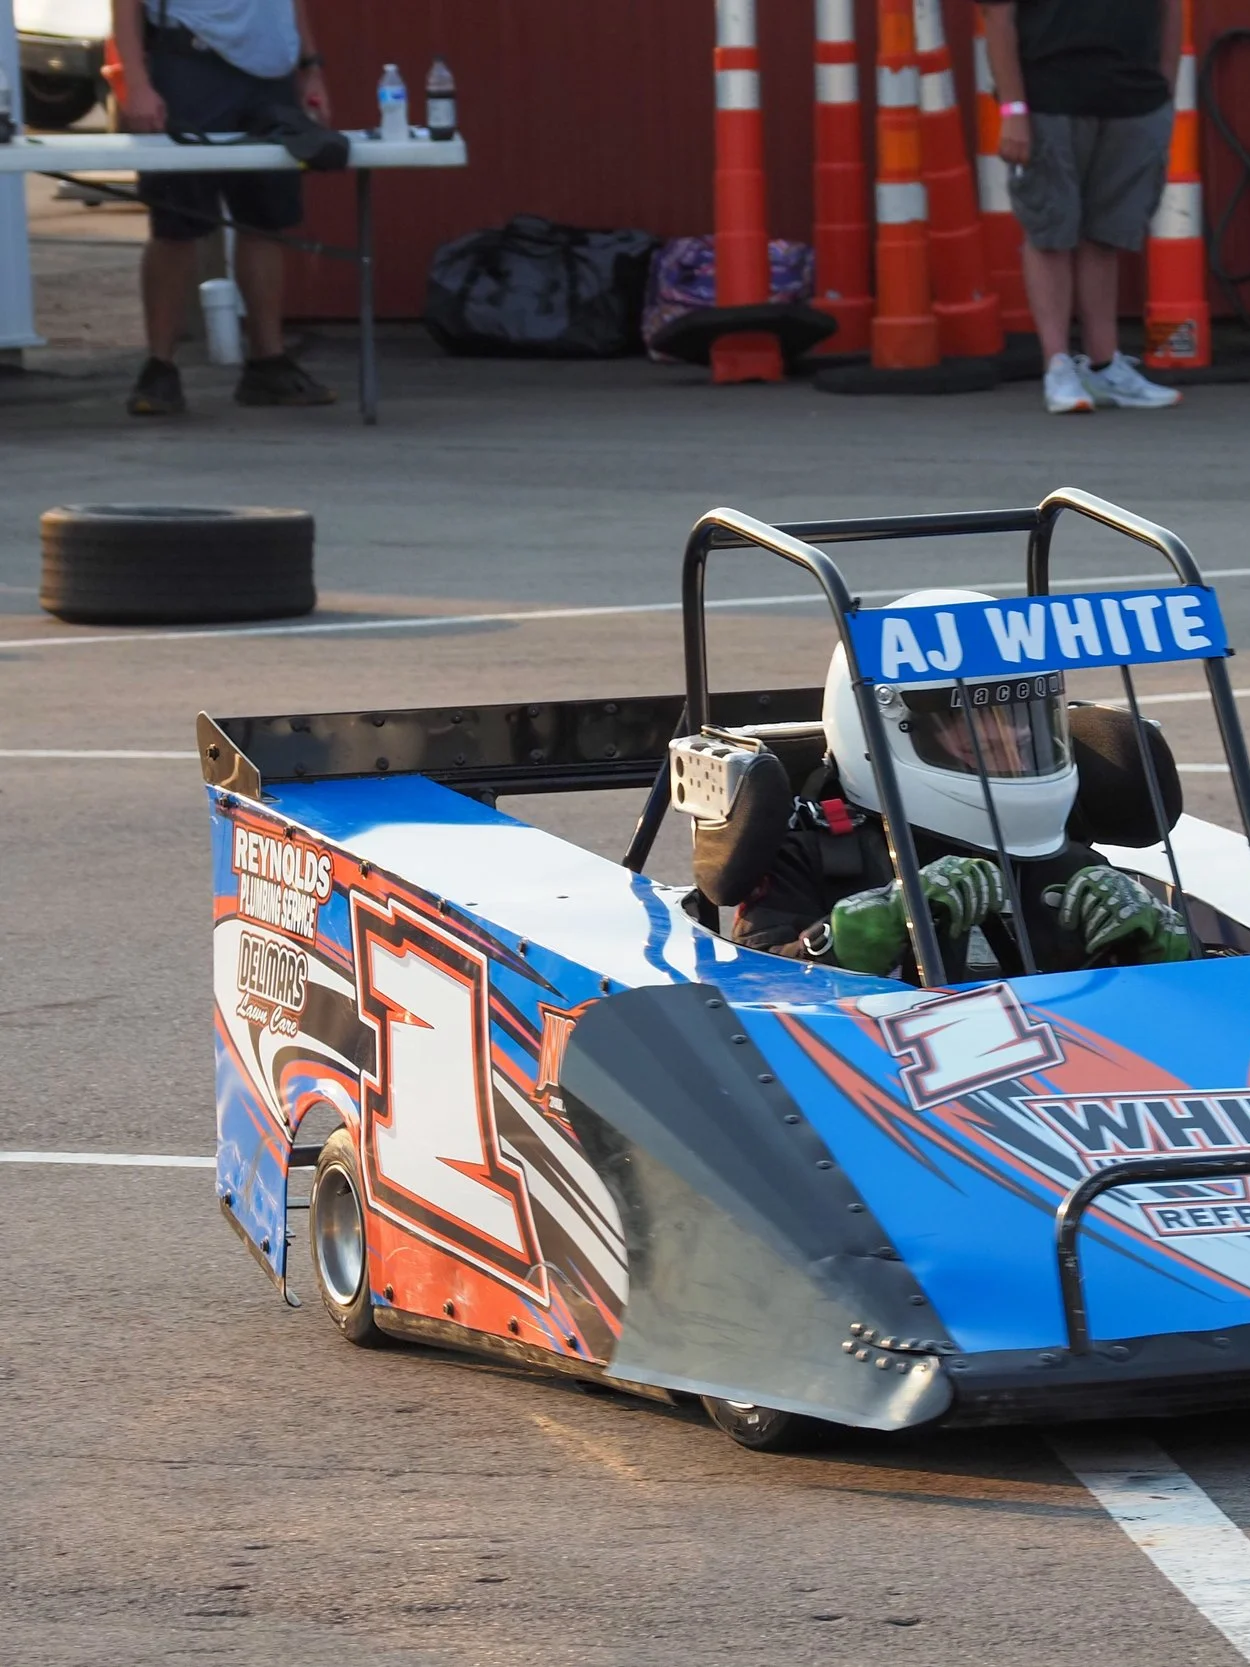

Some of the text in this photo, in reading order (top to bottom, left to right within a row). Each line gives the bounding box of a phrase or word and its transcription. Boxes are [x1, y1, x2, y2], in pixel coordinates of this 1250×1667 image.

[882, 595, 1212, 678] AJ WHITE
[234, 827, 331, 898] REYNOLDS
[239, 873, 317, 939] PLUMBING SERVICE
[239, 936, 307, 1010] DELMARS
[236, 992, 298, 1034] Lawn Care
[885, 985, 1060, 1105] 1
[358, 905, 540, 1290] 1
